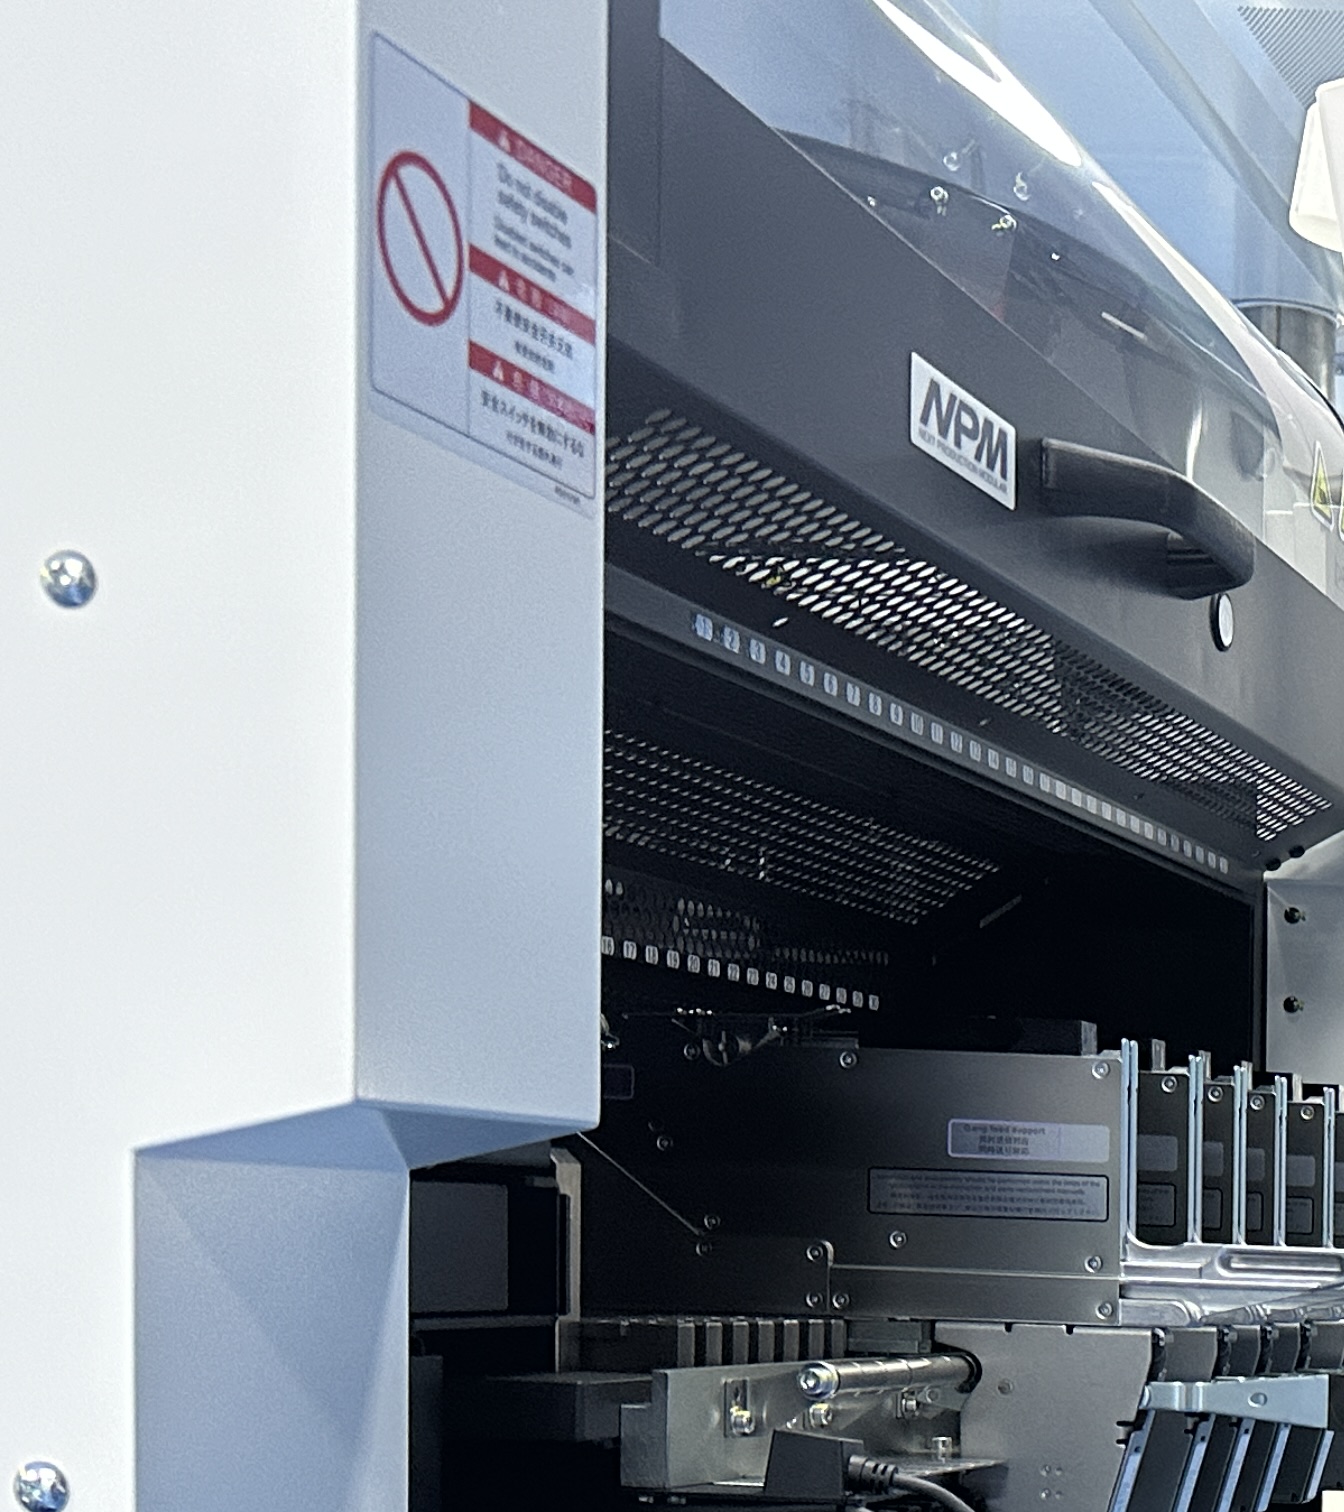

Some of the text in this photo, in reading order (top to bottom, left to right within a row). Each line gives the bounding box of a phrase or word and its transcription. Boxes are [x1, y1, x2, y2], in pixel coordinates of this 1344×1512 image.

[917, 427, 937, 448] NEXT
[919, 378, 1008, 482] NPM
[1012, 1125, 1046, 1136] support
